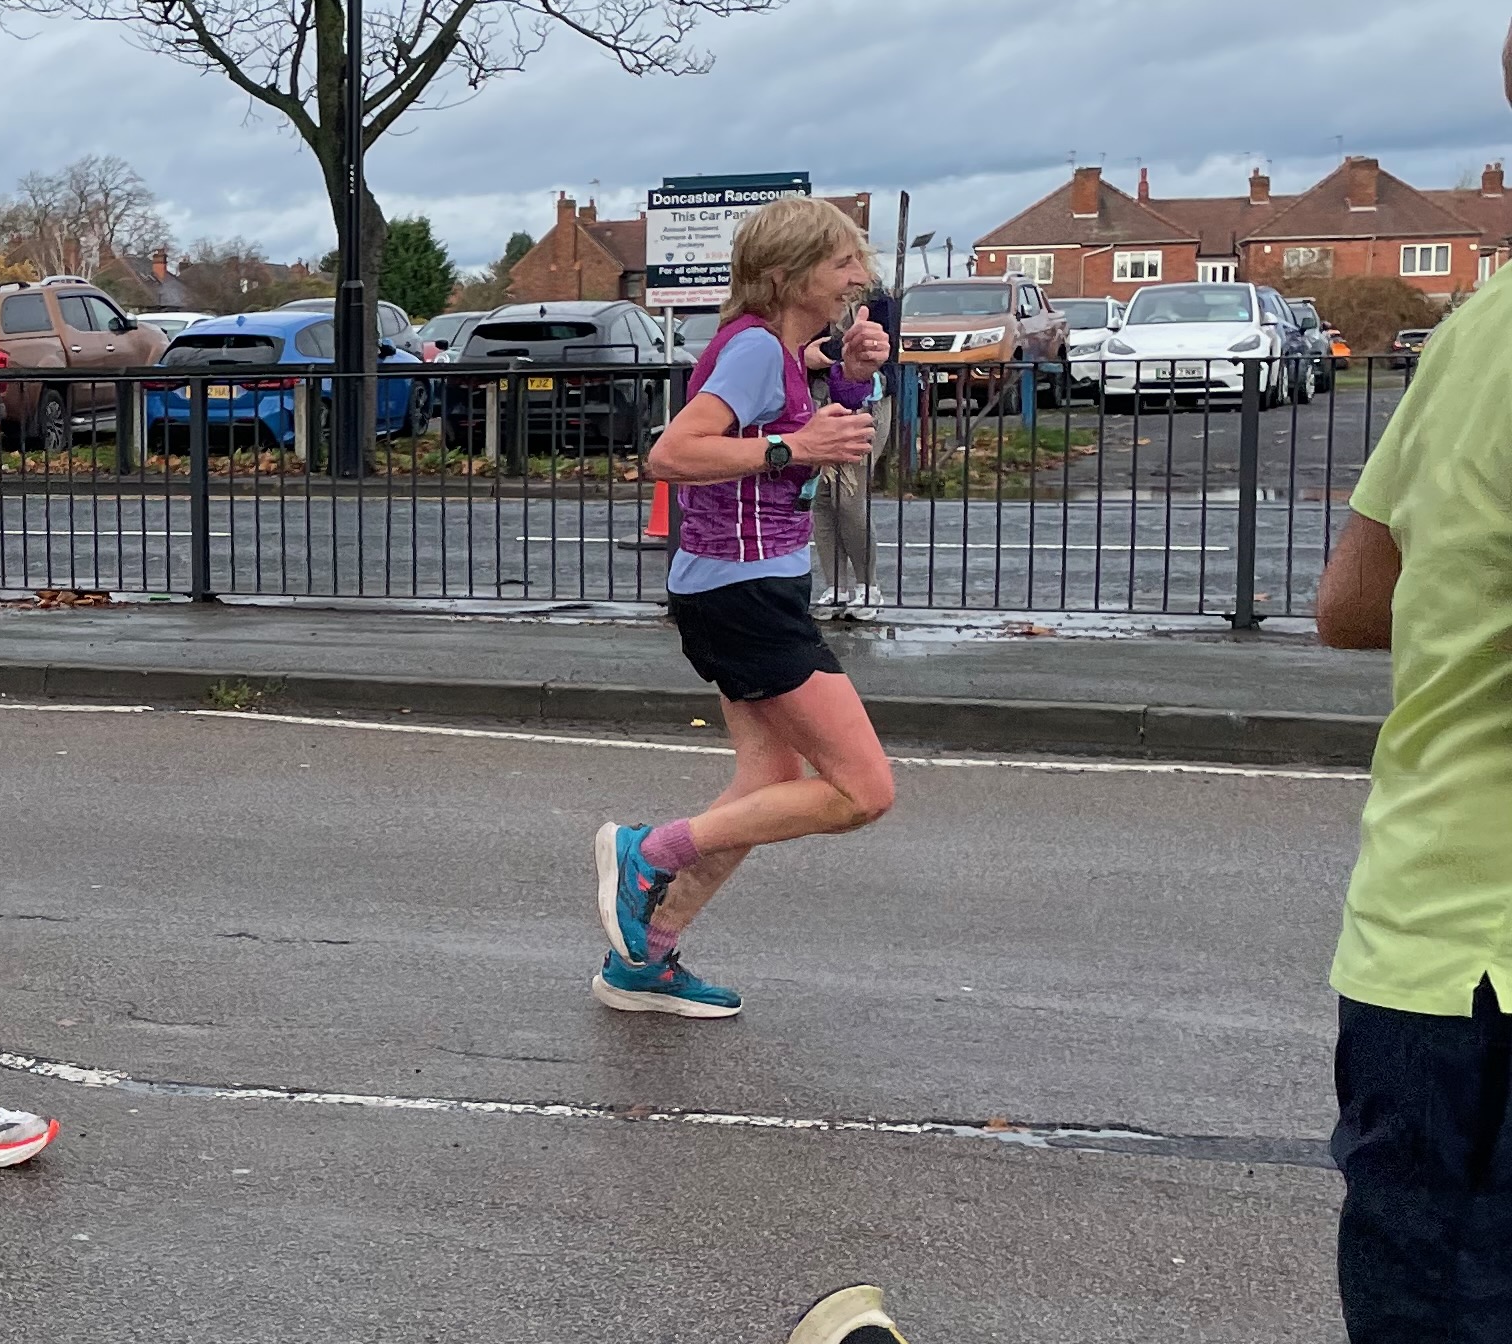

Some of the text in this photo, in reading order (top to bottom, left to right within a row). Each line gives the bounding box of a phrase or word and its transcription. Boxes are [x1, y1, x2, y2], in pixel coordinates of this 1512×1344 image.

[652, 191, 721, 205] Doncaster
[671, 212, 696, 222] This
[699, 211, 721, 221] Car
[659, 267, 673, 275] For
[675, 266, 685, 274] all
[686, 265, 708, 274] other
[679, 274, 730, 285] the signs for
